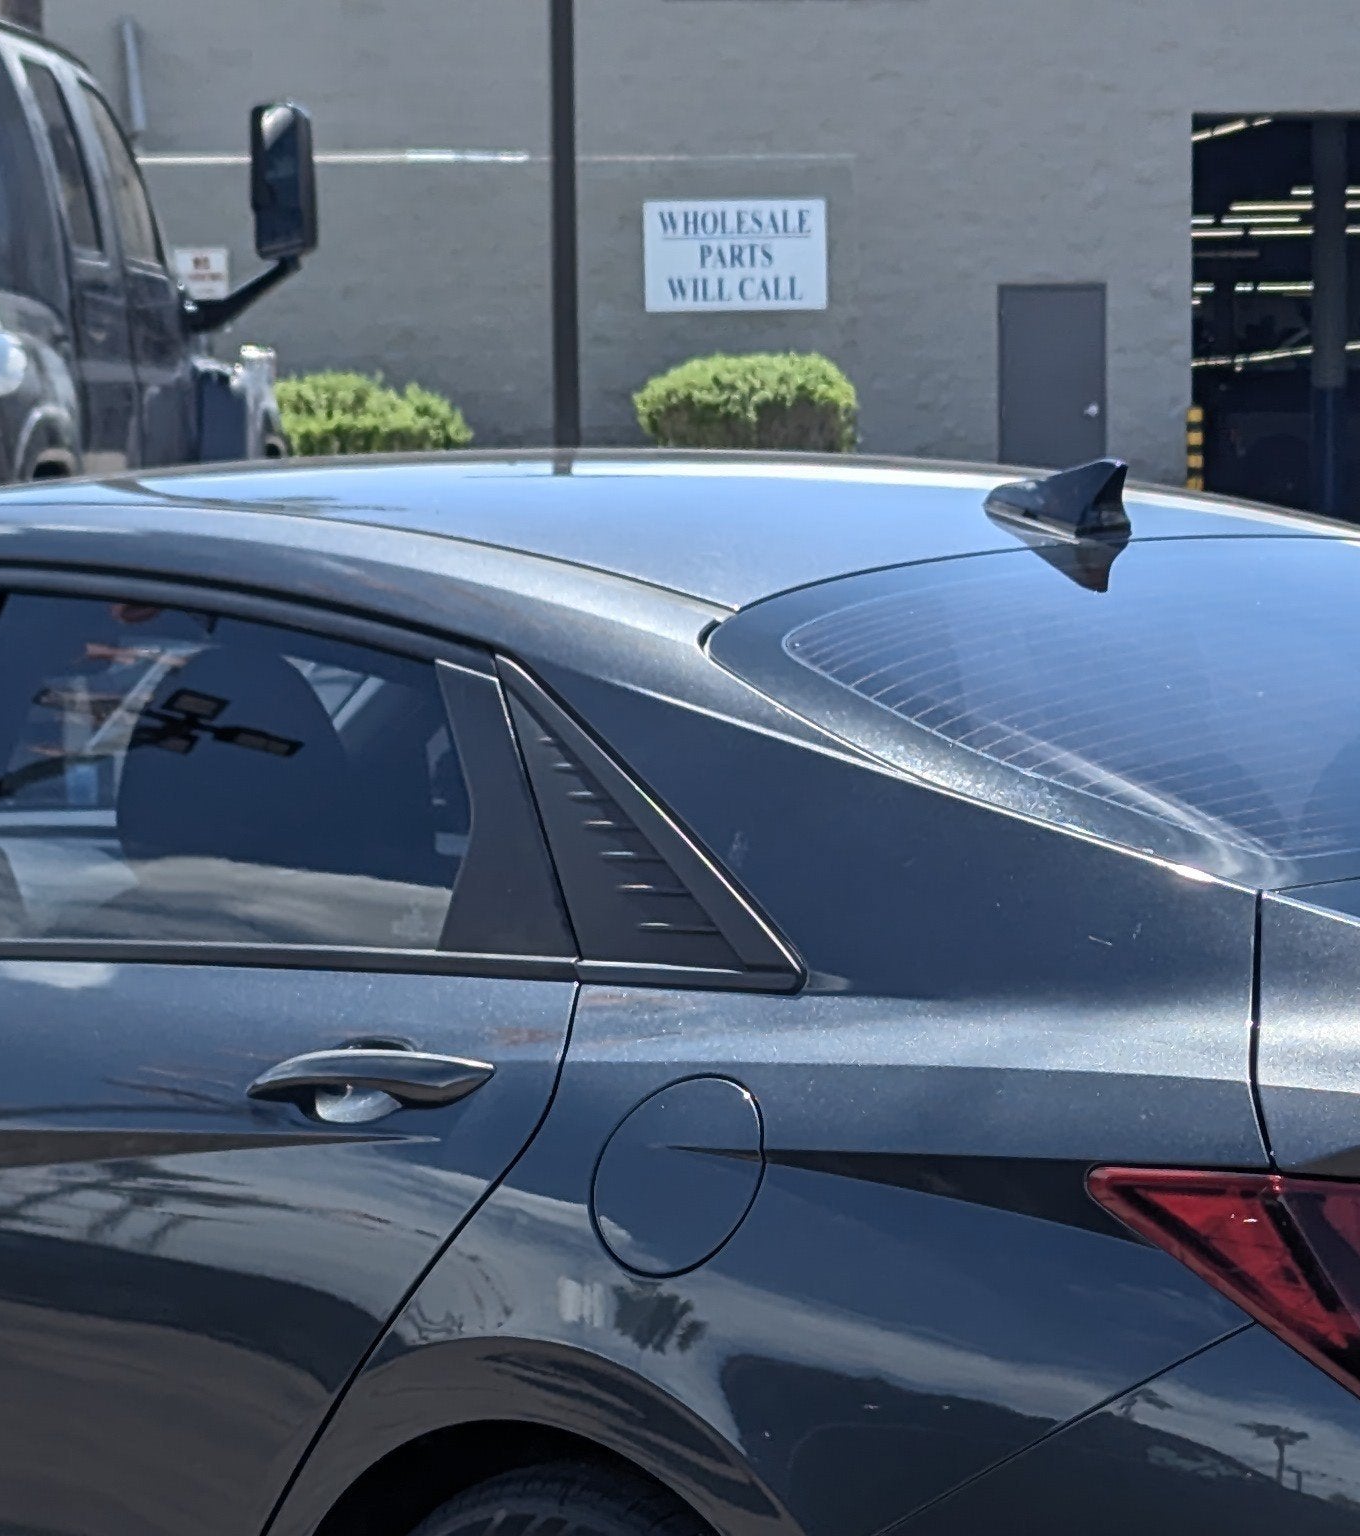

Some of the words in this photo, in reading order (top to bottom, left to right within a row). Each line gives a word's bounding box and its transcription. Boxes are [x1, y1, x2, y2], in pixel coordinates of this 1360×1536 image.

[658, 209, 811, 235] WHOLESALE
[699, 243, 773, 268] PARTS
[667, 276, 731, 302] WILL
[739, 275, 804, 301] CALL
